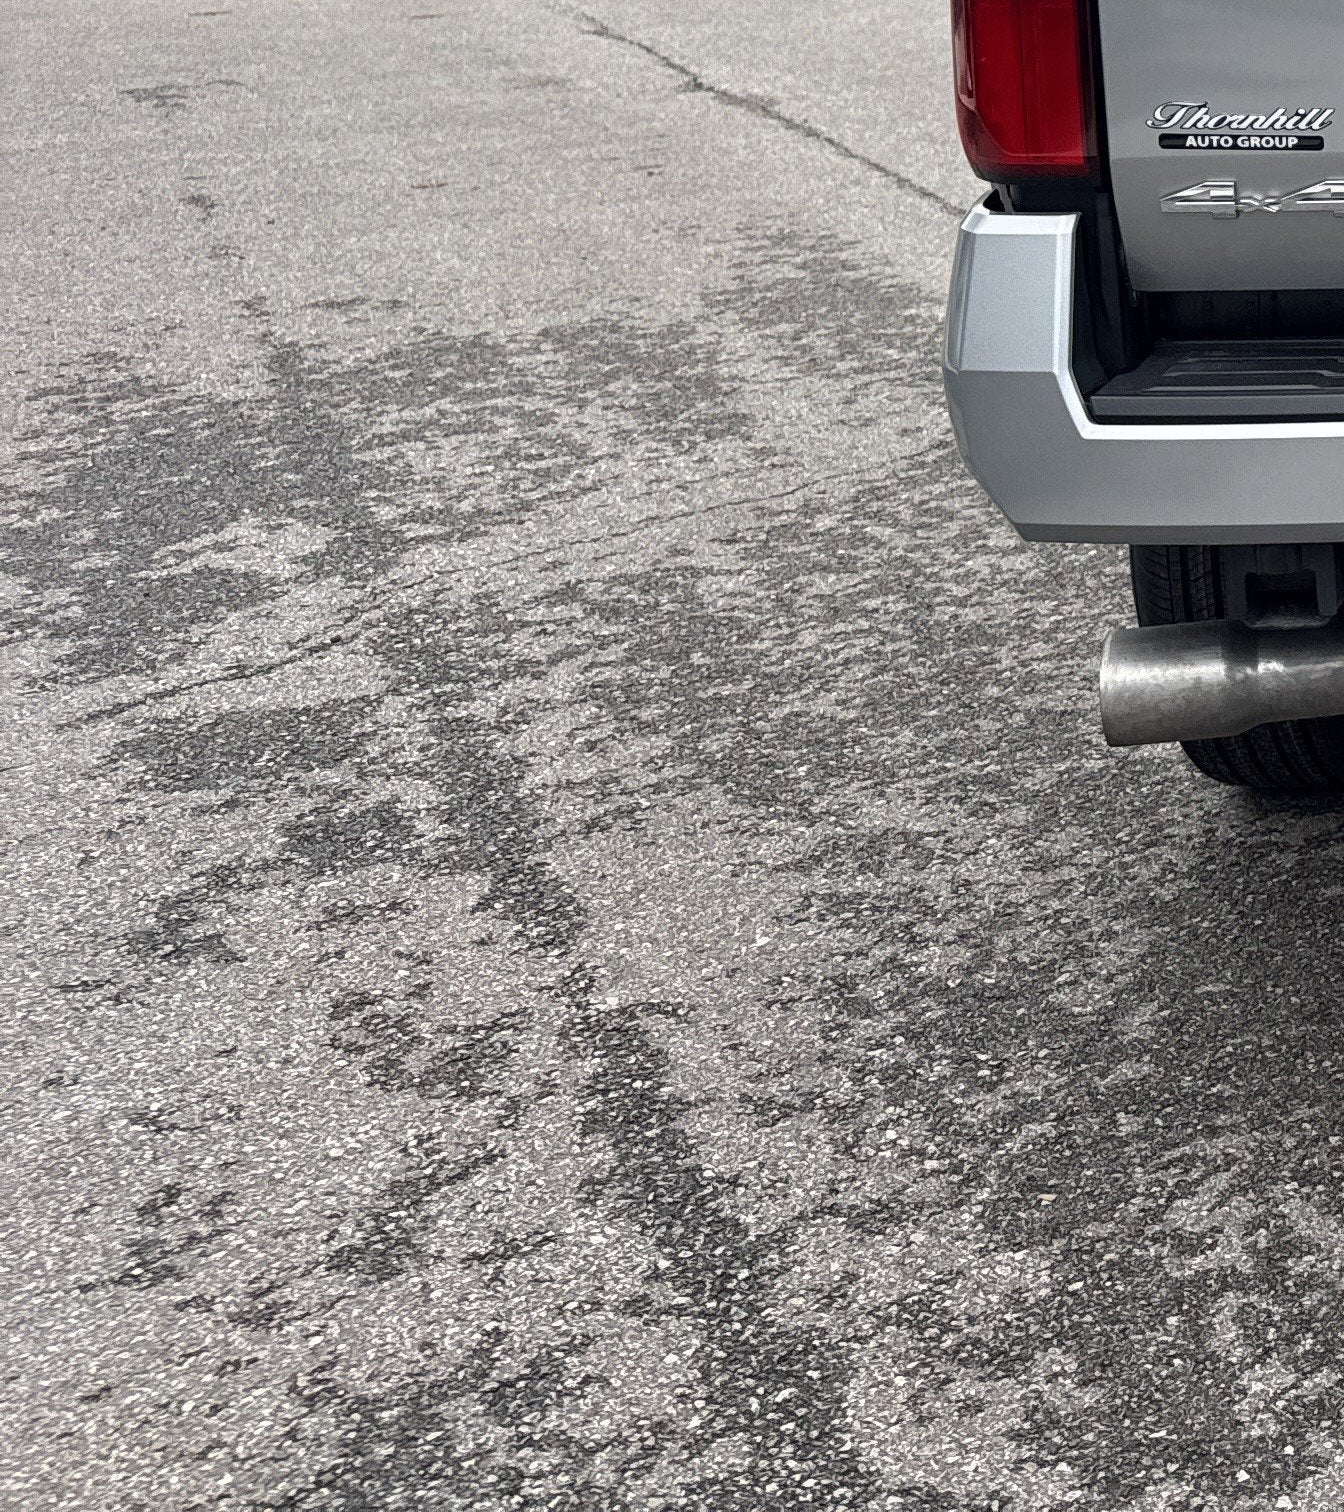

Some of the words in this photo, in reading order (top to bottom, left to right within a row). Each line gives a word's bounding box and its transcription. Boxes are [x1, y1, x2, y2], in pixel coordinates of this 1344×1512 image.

[1145, 100, 1335, 131] Thornhill
[1185, 135, 1233, 148] AUTO
[1236, 135, 1299, 149] GROUP
